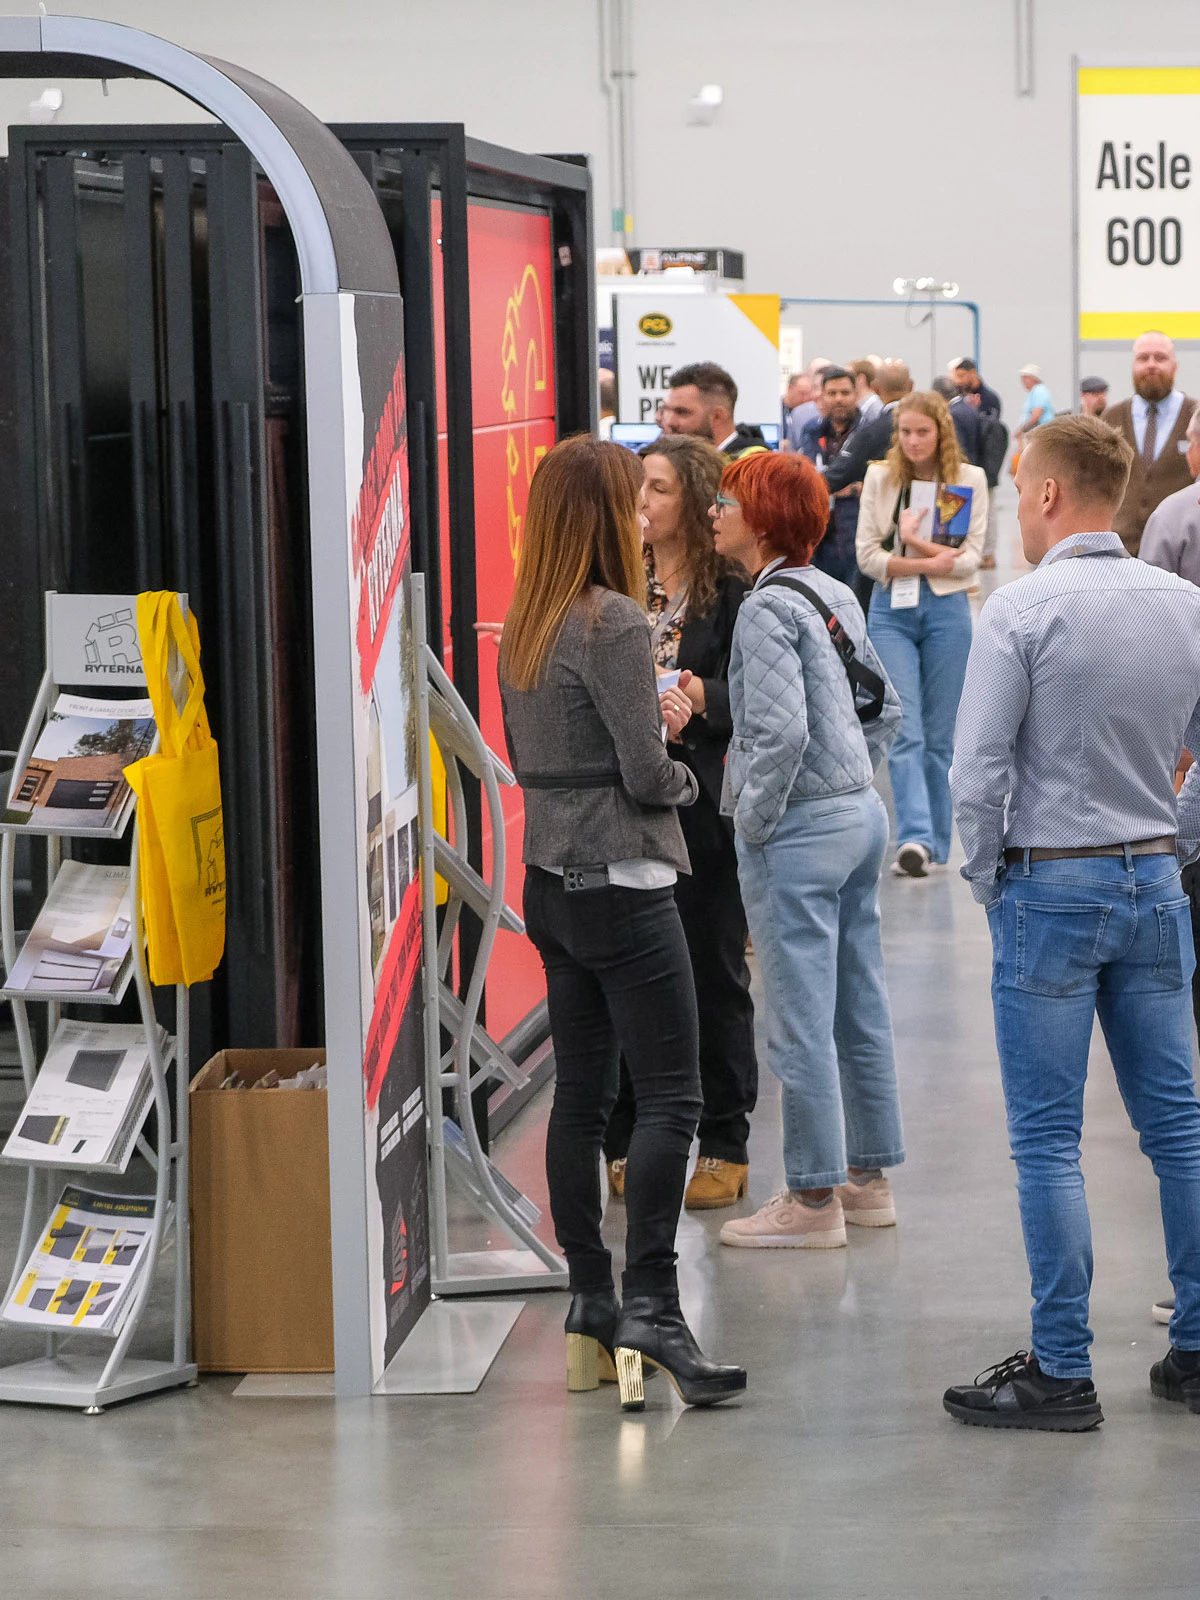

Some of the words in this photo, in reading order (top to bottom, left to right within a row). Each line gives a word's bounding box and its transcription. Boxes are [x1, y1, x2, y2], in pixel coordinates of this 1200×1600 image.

[1097, 140, 1191, 190] Aisle
[1107, 216, 1182, 267] 600
[638, 365, 671, 390] WE
[367, 459, 405, 645] RYTERNA
[85, 664, 143, 674] RYTERNA
